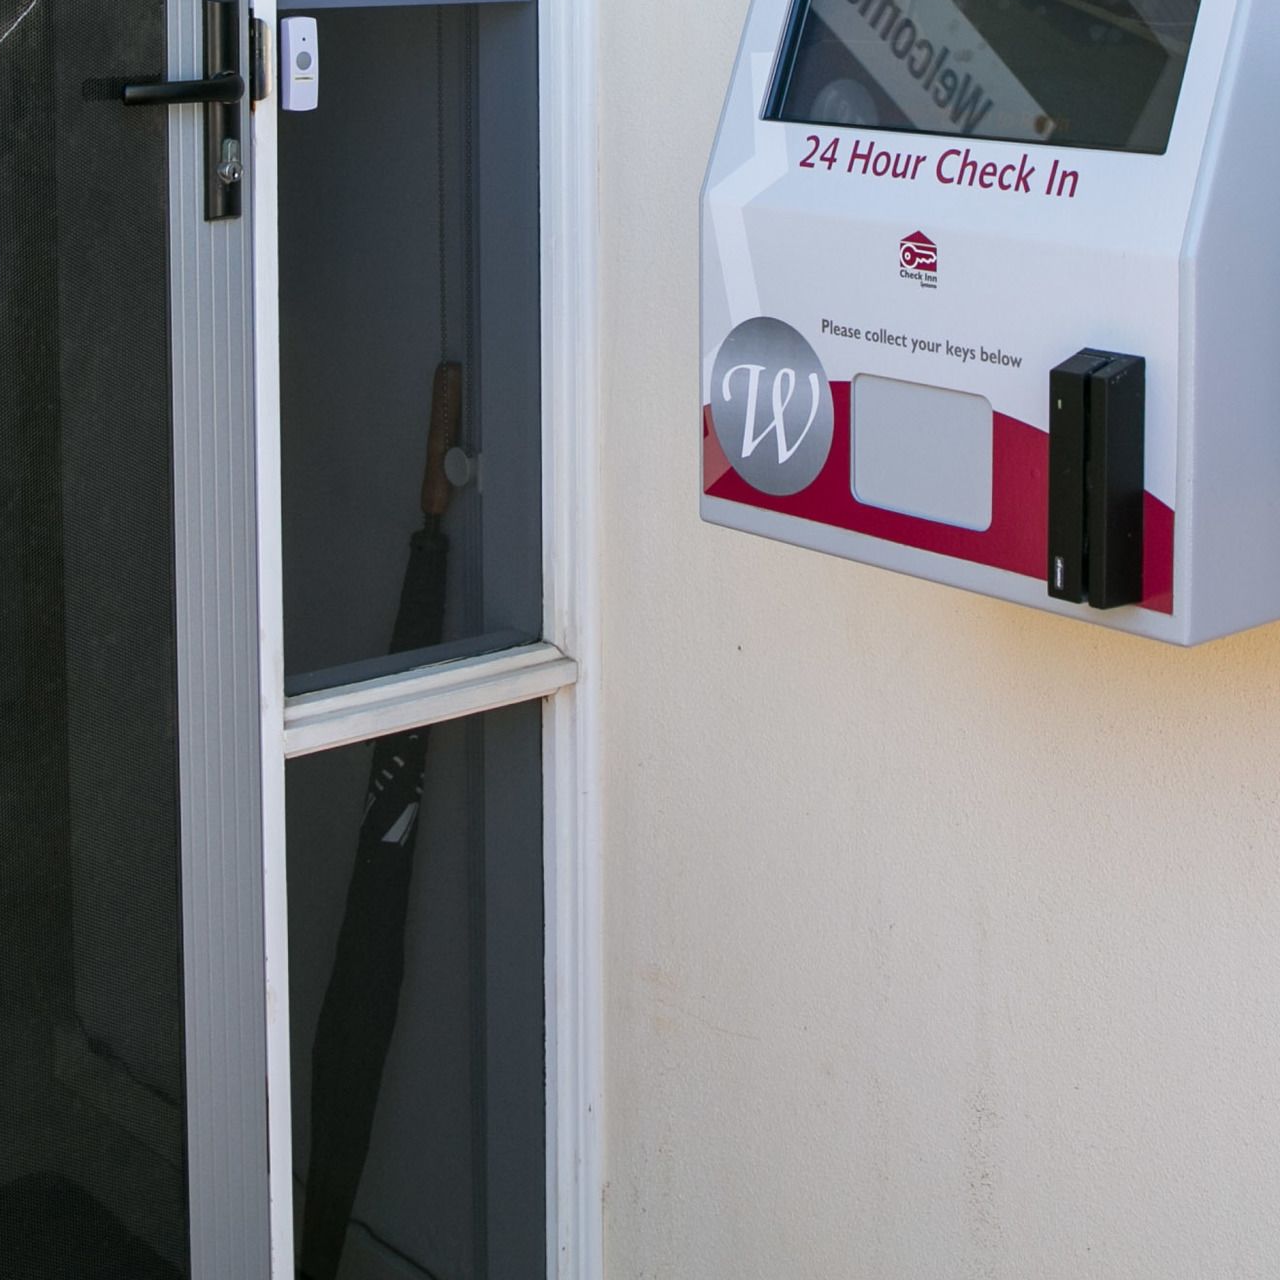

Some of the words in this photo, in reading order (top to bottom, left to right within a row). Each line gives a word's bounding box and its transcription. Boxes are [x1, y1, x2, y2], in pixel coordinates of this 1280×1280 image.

[800, 135, 838, 170] 24
[846, 140, 926, 181] Hour
[936, 148, 1036, 195] Check
[1044, 159, 1079, 199] In
[900, 269, 922, 280] Check
[925, 273, 937, 282] Inn
[821, 319, 861, 341] Please
[865, 327, 907, 348] collect
[911, 335, 942, 356] your
[946, 339, 976, 362] keys
[980, 344, 1022, 370] below
[721, 362, 820, 465] W
